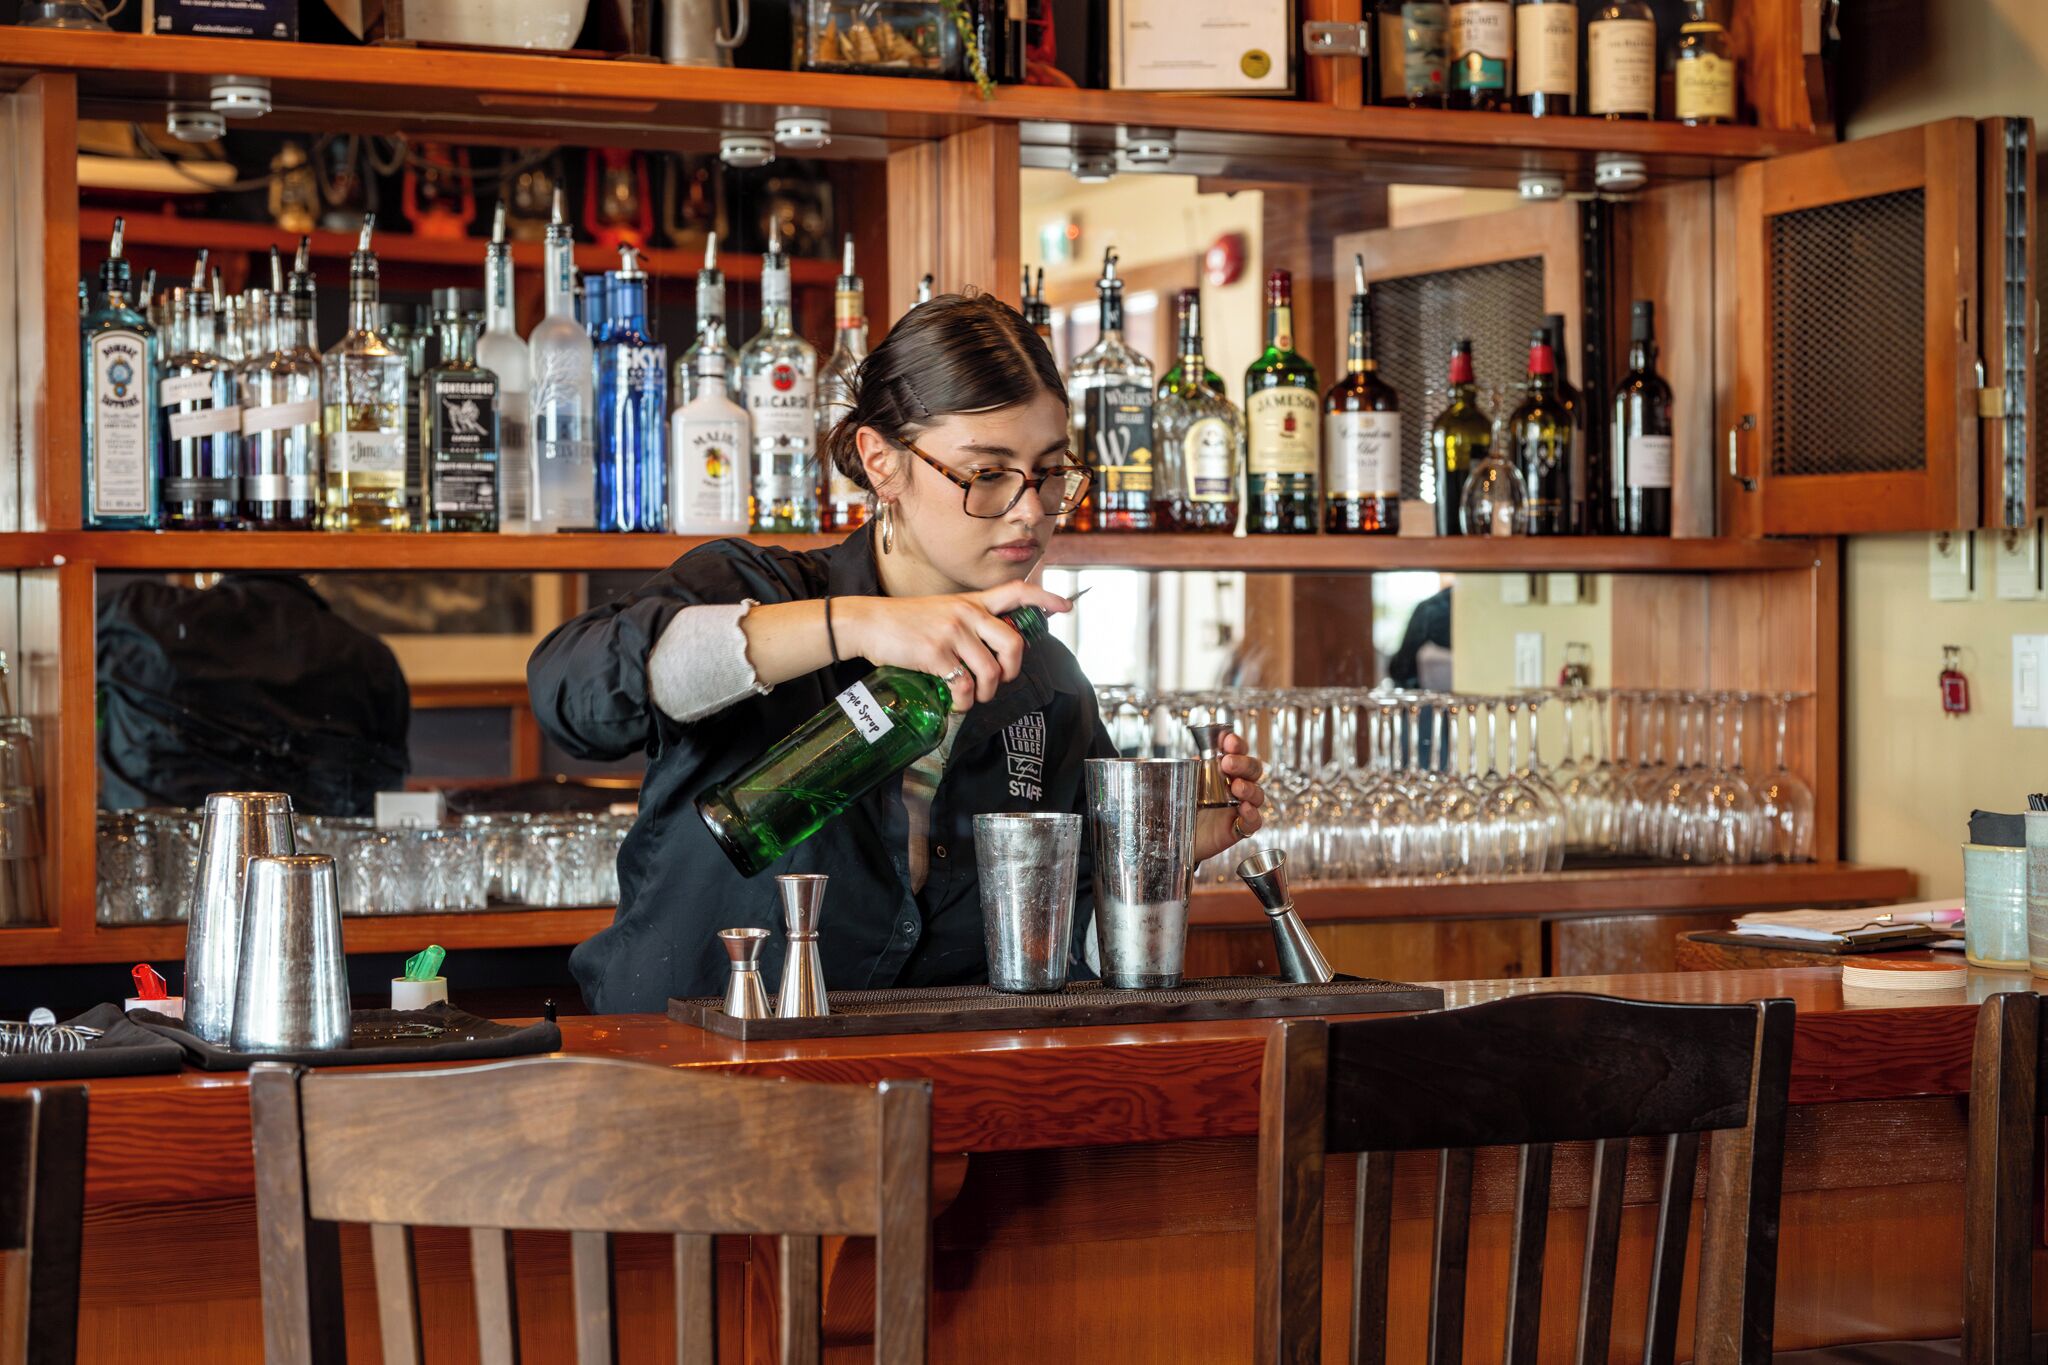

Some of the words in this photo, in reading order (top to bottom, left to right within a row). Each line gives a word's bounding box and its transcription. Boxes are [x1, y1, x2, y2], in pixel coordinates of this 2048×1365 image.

[693, 430, 742, 447] MALIB
[1095, 425, 1131, 466] W
[858, 704, 881, 734] Syrup
[1011, 714, 1043, 728] DDLE
[1008, 725, 1041, 741] BEACH
[1011, 739, 1041, 756] LODGE
[1008, 779, 1043, 802] STAFF
